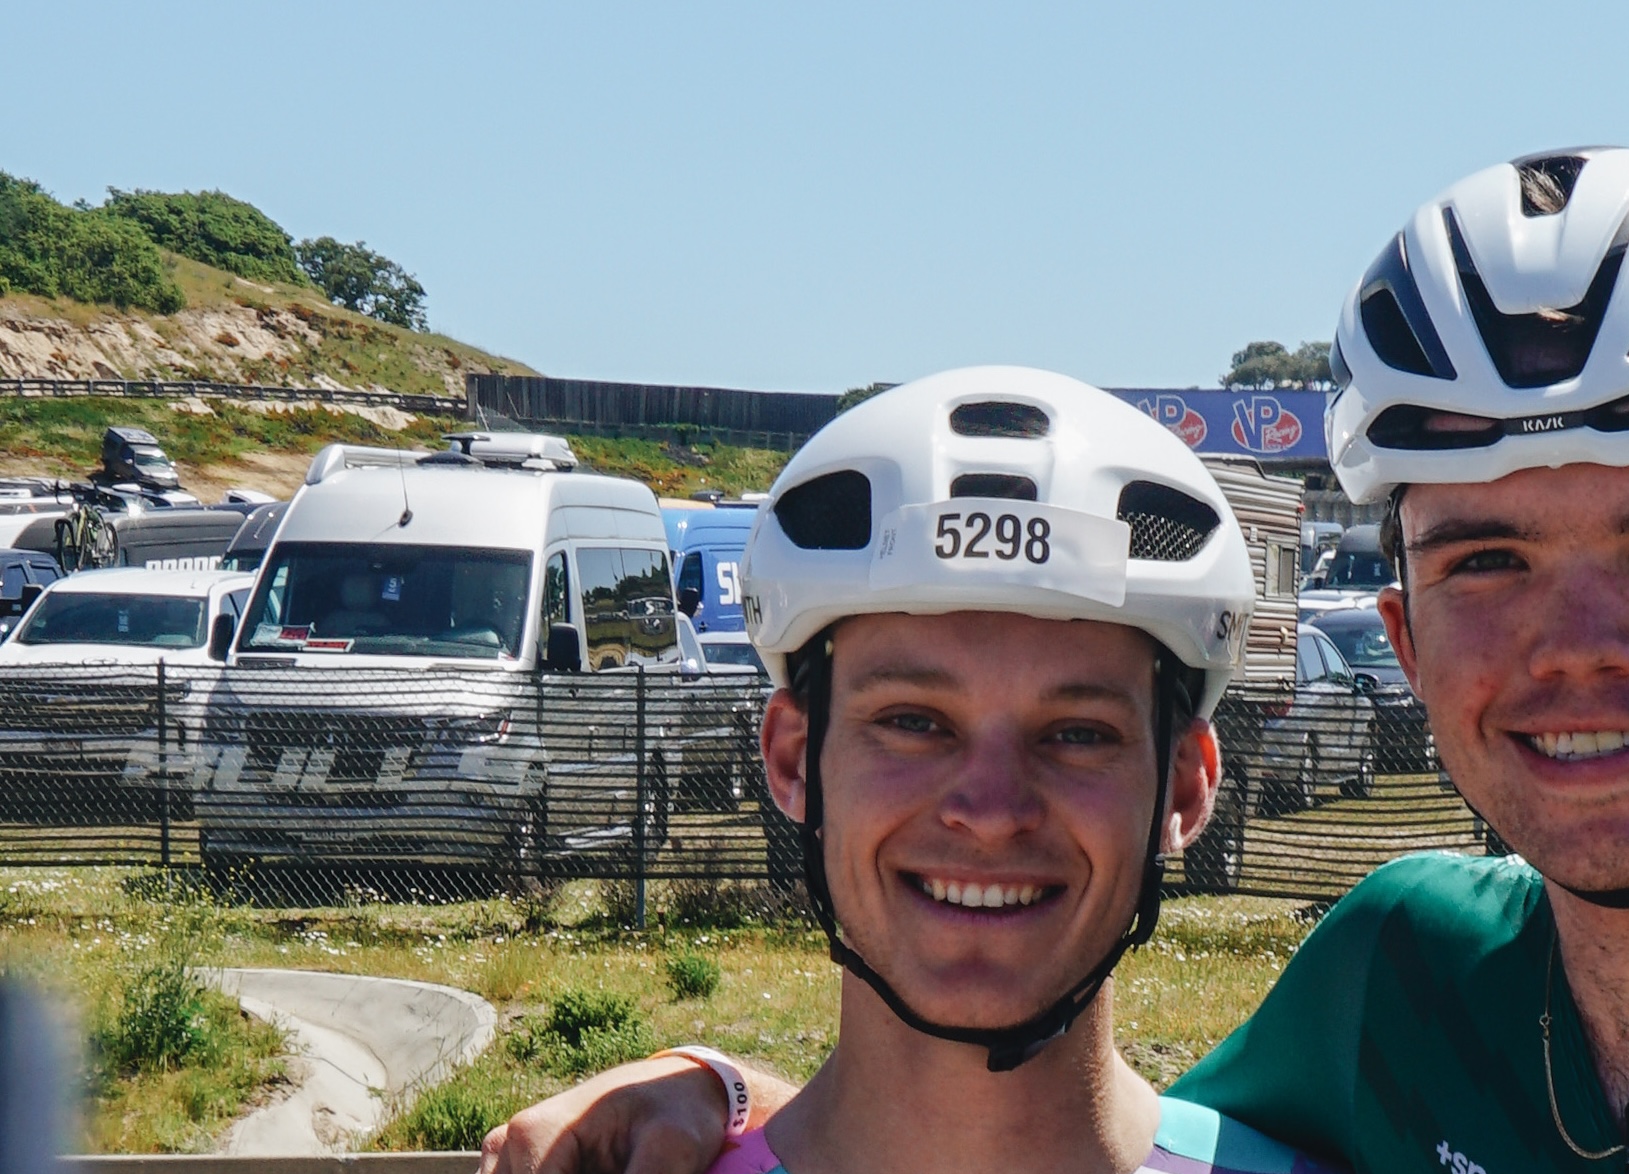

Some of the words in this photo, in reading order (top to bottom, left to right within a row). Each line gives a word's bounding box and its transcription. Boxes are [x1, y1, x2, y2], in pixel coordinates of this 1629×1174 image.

[1232, 396, 1282, 451] VP
[1522, 415, 1565, 432] KASK
[935, 512, 1051, 565] 5298
